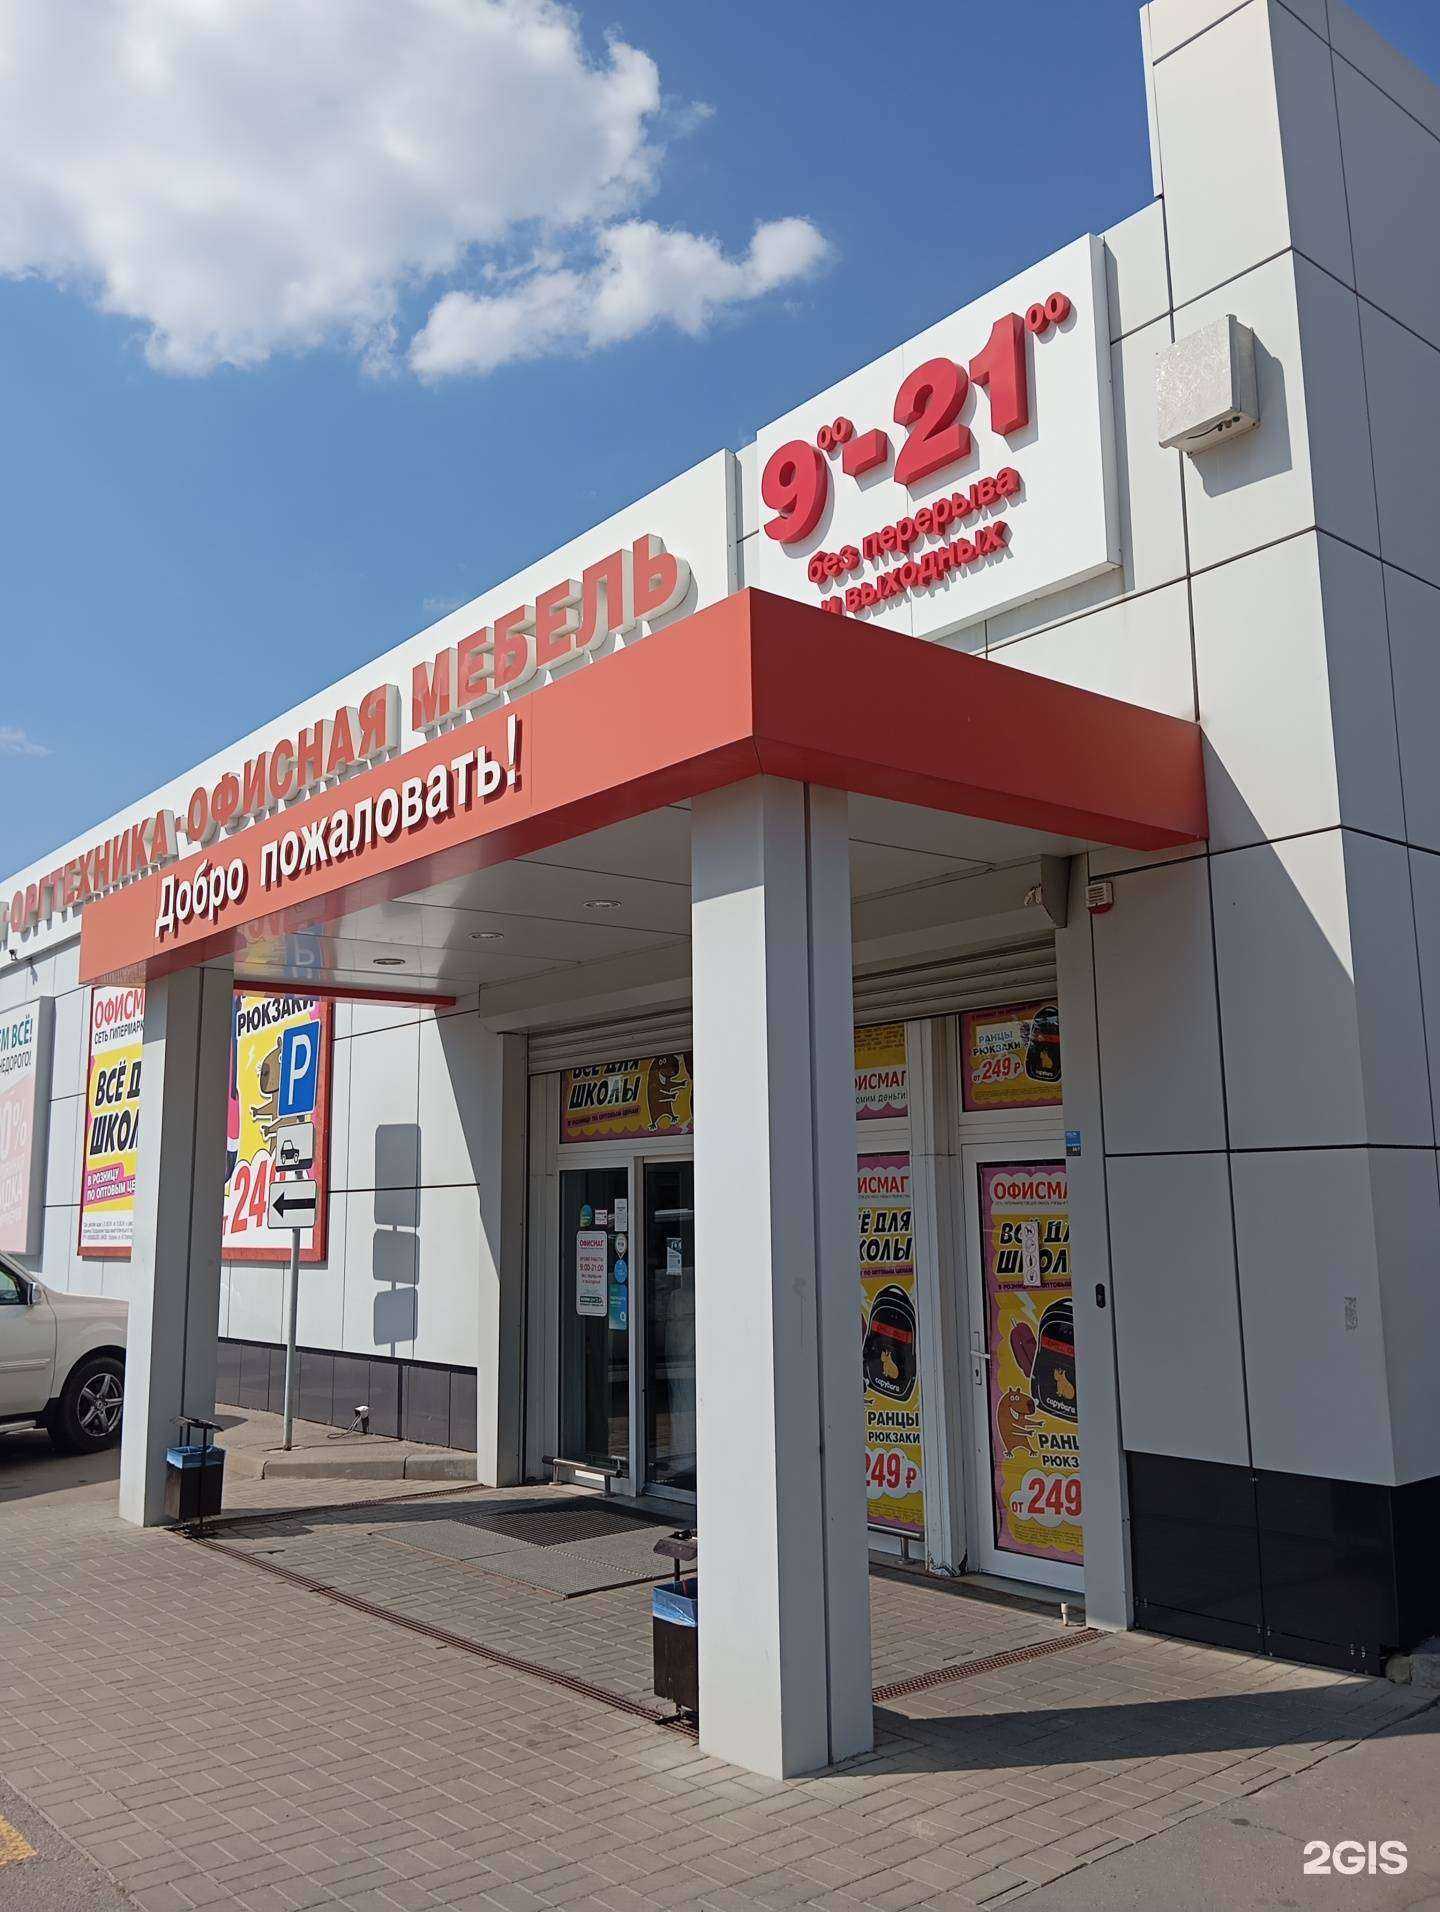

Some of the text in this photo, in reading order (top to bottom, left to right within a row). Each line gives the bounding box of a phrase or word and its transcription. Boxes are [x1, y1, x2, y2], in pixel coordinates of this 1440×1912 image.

[808, 467, 1020, 584] без перерыва
[846, 521, 1008, 613] выходных
[187, 684, 400, 842] ОФИСНАЯ
[412, 533, 690, 733] МЕБЕЛЬ
[155, 714, 518, 938] Добро пожаловать!
[95, 990, 145, 1029] ОФИСМ
[12, 1014, 33, 1048] ВСЁ!
[94, 1030, 109, 1045] СЕТЬ
[0, 1050, 32, 1075] ЕДОРОГО!
[287, 1034, 312, 1106] P
[981, 1056, 1012, 1080] 249
[95, 1060, 127, 1106] ВСЁ
[568, 1076, 641, 1109] ШКОЛЫ
[854, 1070, 906, 1091] ИСМАГ
[858, 1210, 912, 1234] Ё ДЛЯ
[867, 1411, 919, 1428] РАНЦЫ
[868, 1431, 921, 1444] РЮКЗАКИ
[1027, 1478, 1082, 1516] 249
